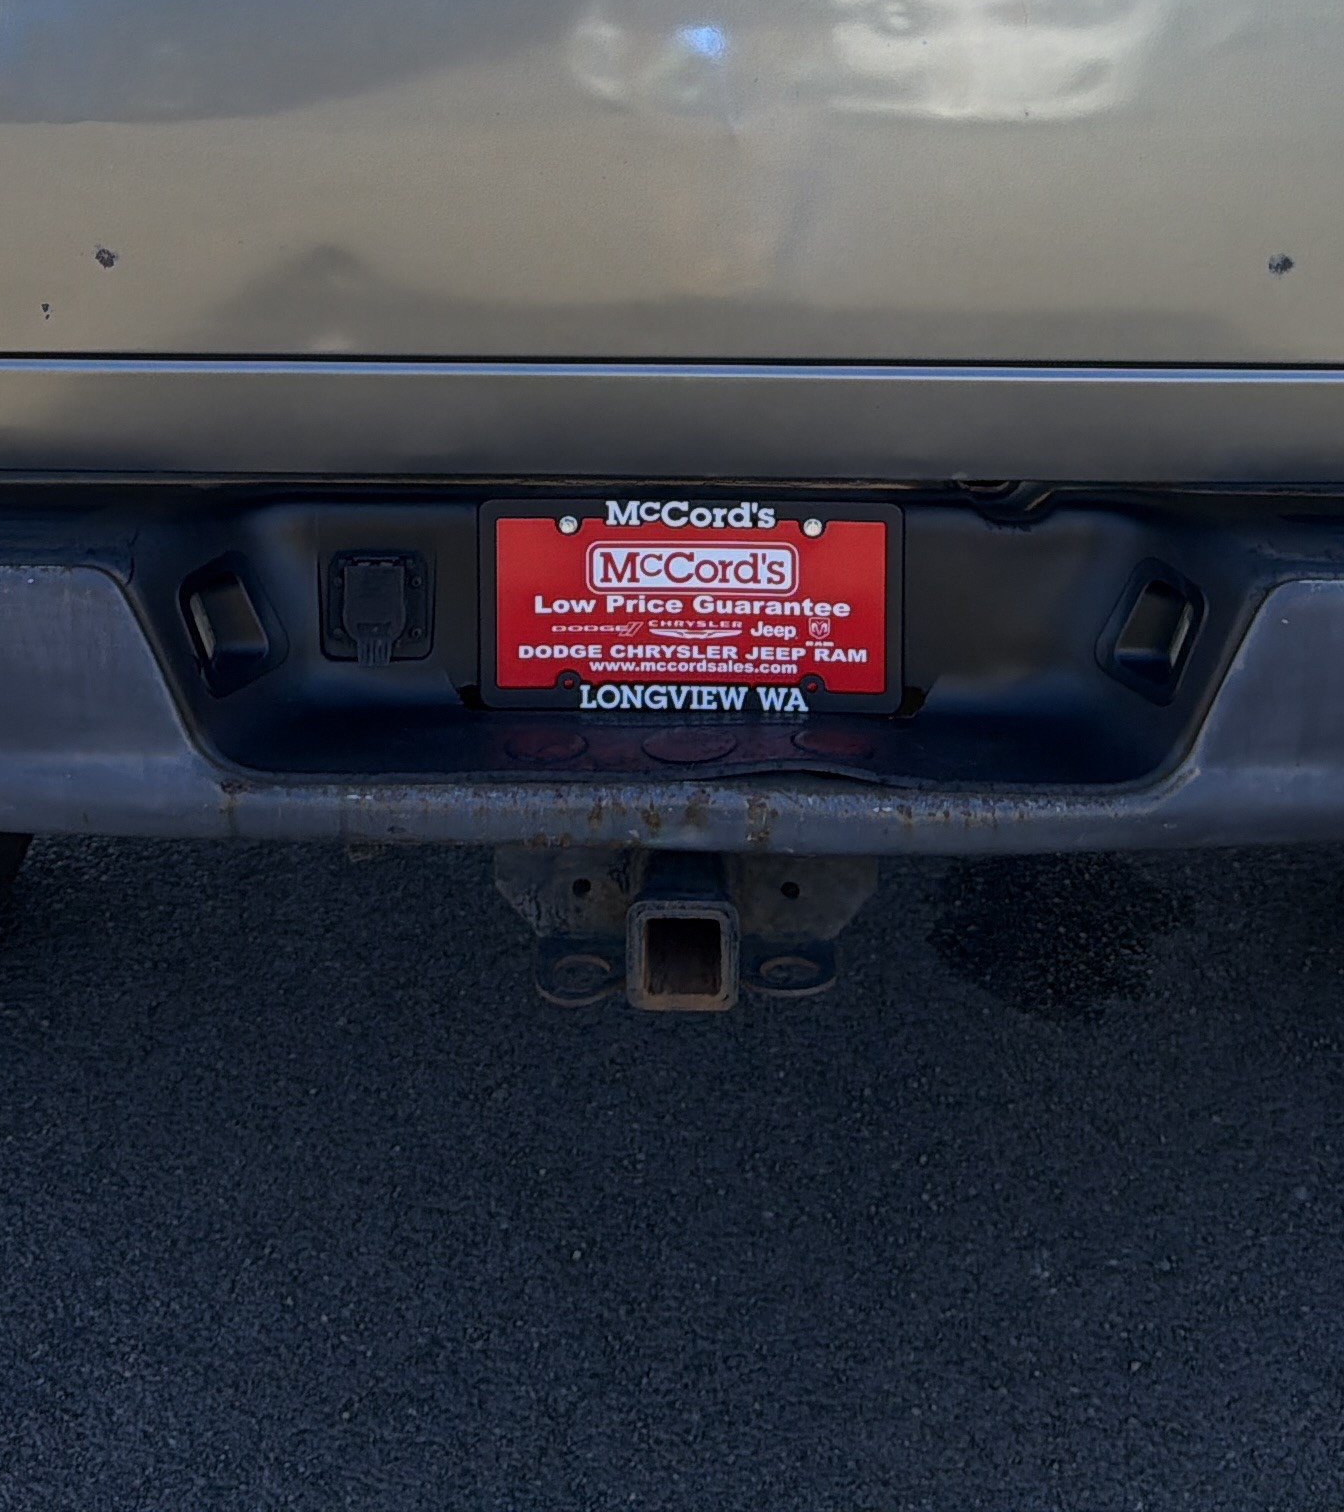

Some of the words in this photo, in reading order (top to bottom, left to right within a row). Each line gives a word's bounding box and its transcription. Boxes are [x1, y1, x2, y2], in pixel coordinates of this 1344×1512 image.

[605, 500, 776, 529] McCord's
[599, 551, 786, 585] McCord's
[534, 595, 597, 614] Low
[606, 594, 683, 614] Price
[692, 595, 851, 618] Guarantee
[551, 624, 628, 633] DODGE
[648, 619, 743, 629] CHRYSLER
[750, 620, 797, 640] Jeep
[518, 644, 603, 659] DODGE
[609, 644, 739, 660] CHRYSLER
[744, 646, 806, 661] JEEP
[814, 648, 868, 663] RAM
[589, 659, 798, 675] www.mccordsales.com
[579, 684, 749, 711] LONGVIEW
[756, 686, 809, 712] WA
